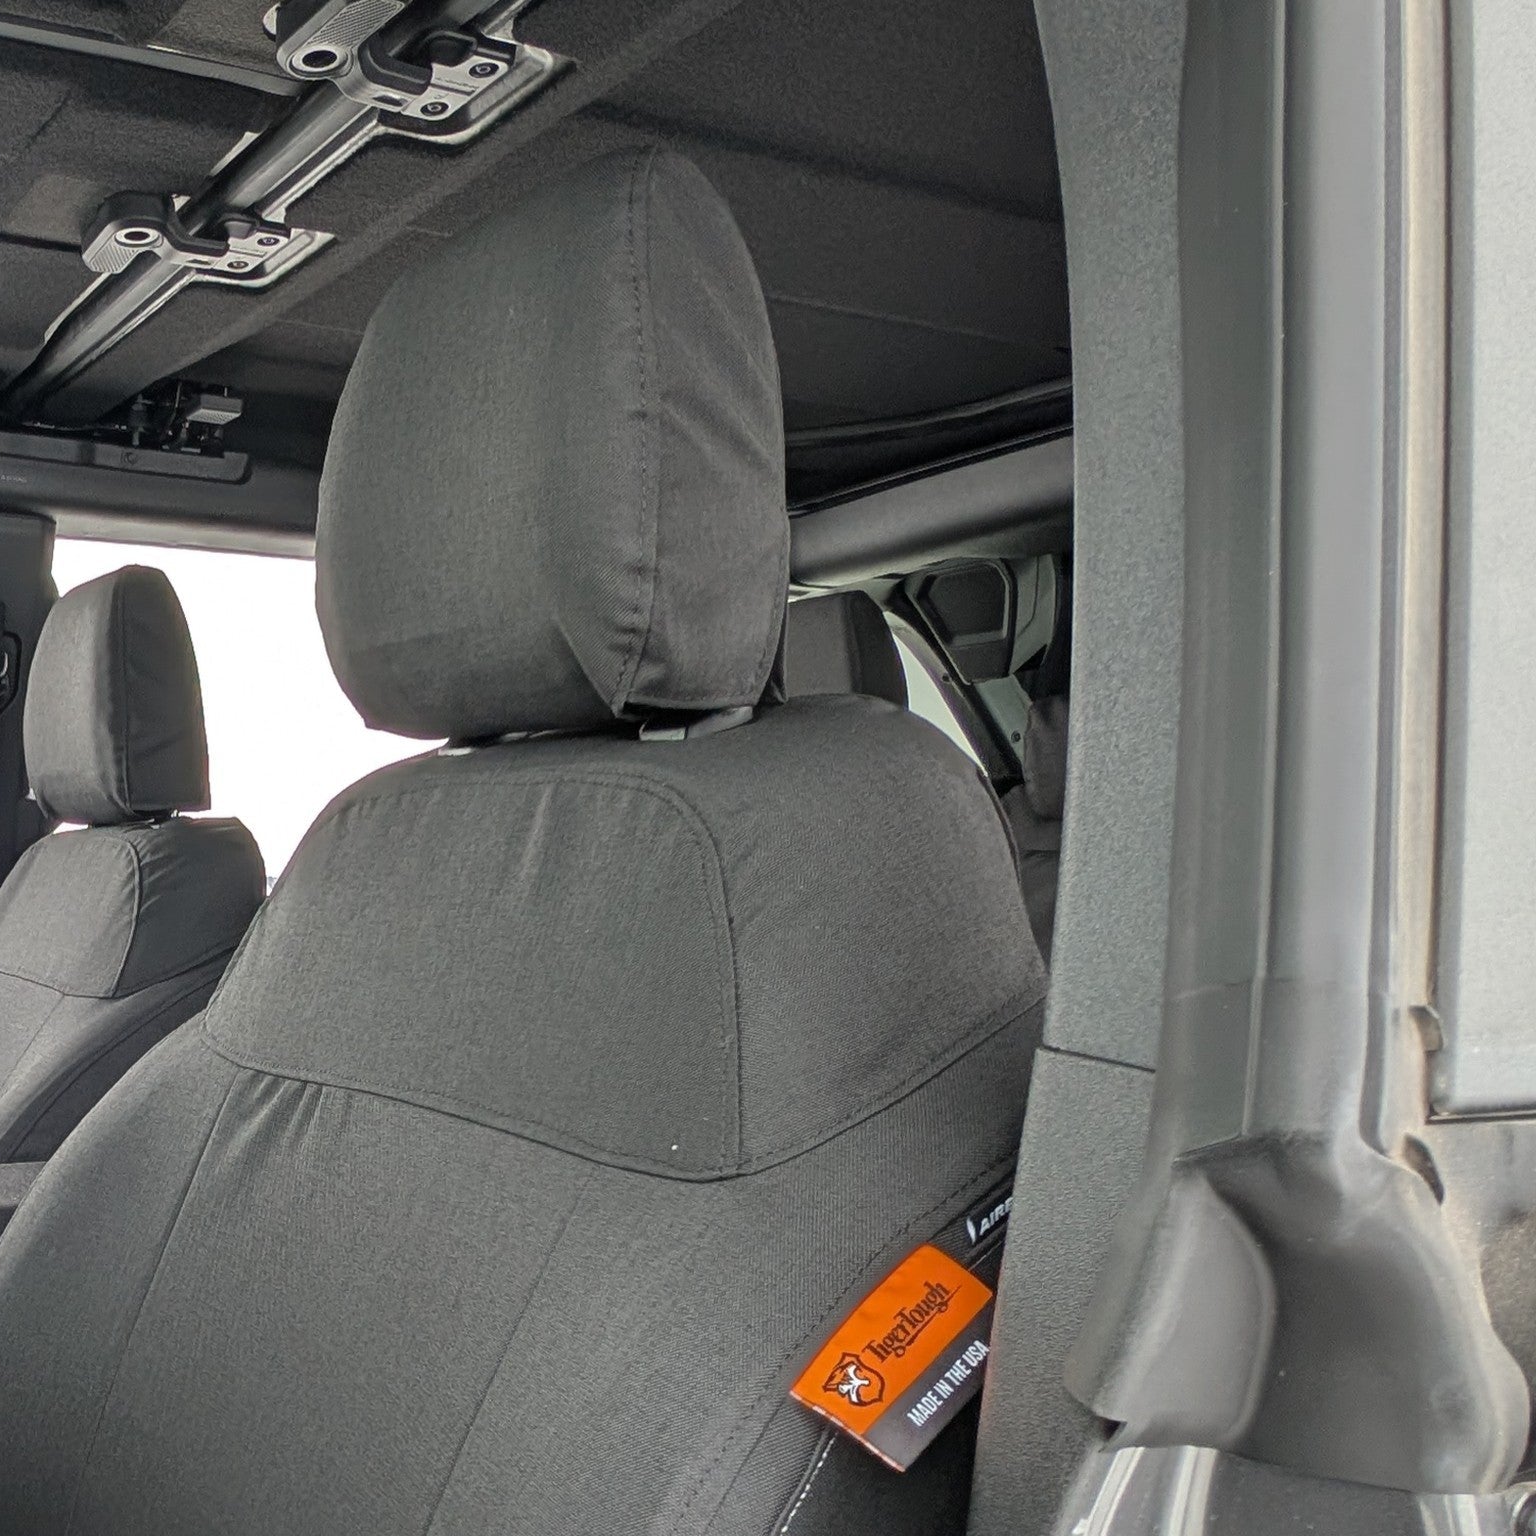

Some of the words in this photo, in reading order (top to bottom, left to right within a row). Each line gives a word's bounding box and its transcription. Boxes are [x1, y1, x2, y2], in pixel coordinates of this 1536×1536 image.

[862, 1281, 962, 1363] TigerTough
[907, 1391, 943, 1426] MADE
[933, 1379, 954, 1399] IN
[944, 1359, 972, 1386] THE
[962, 1340, 990, 1367] USA
